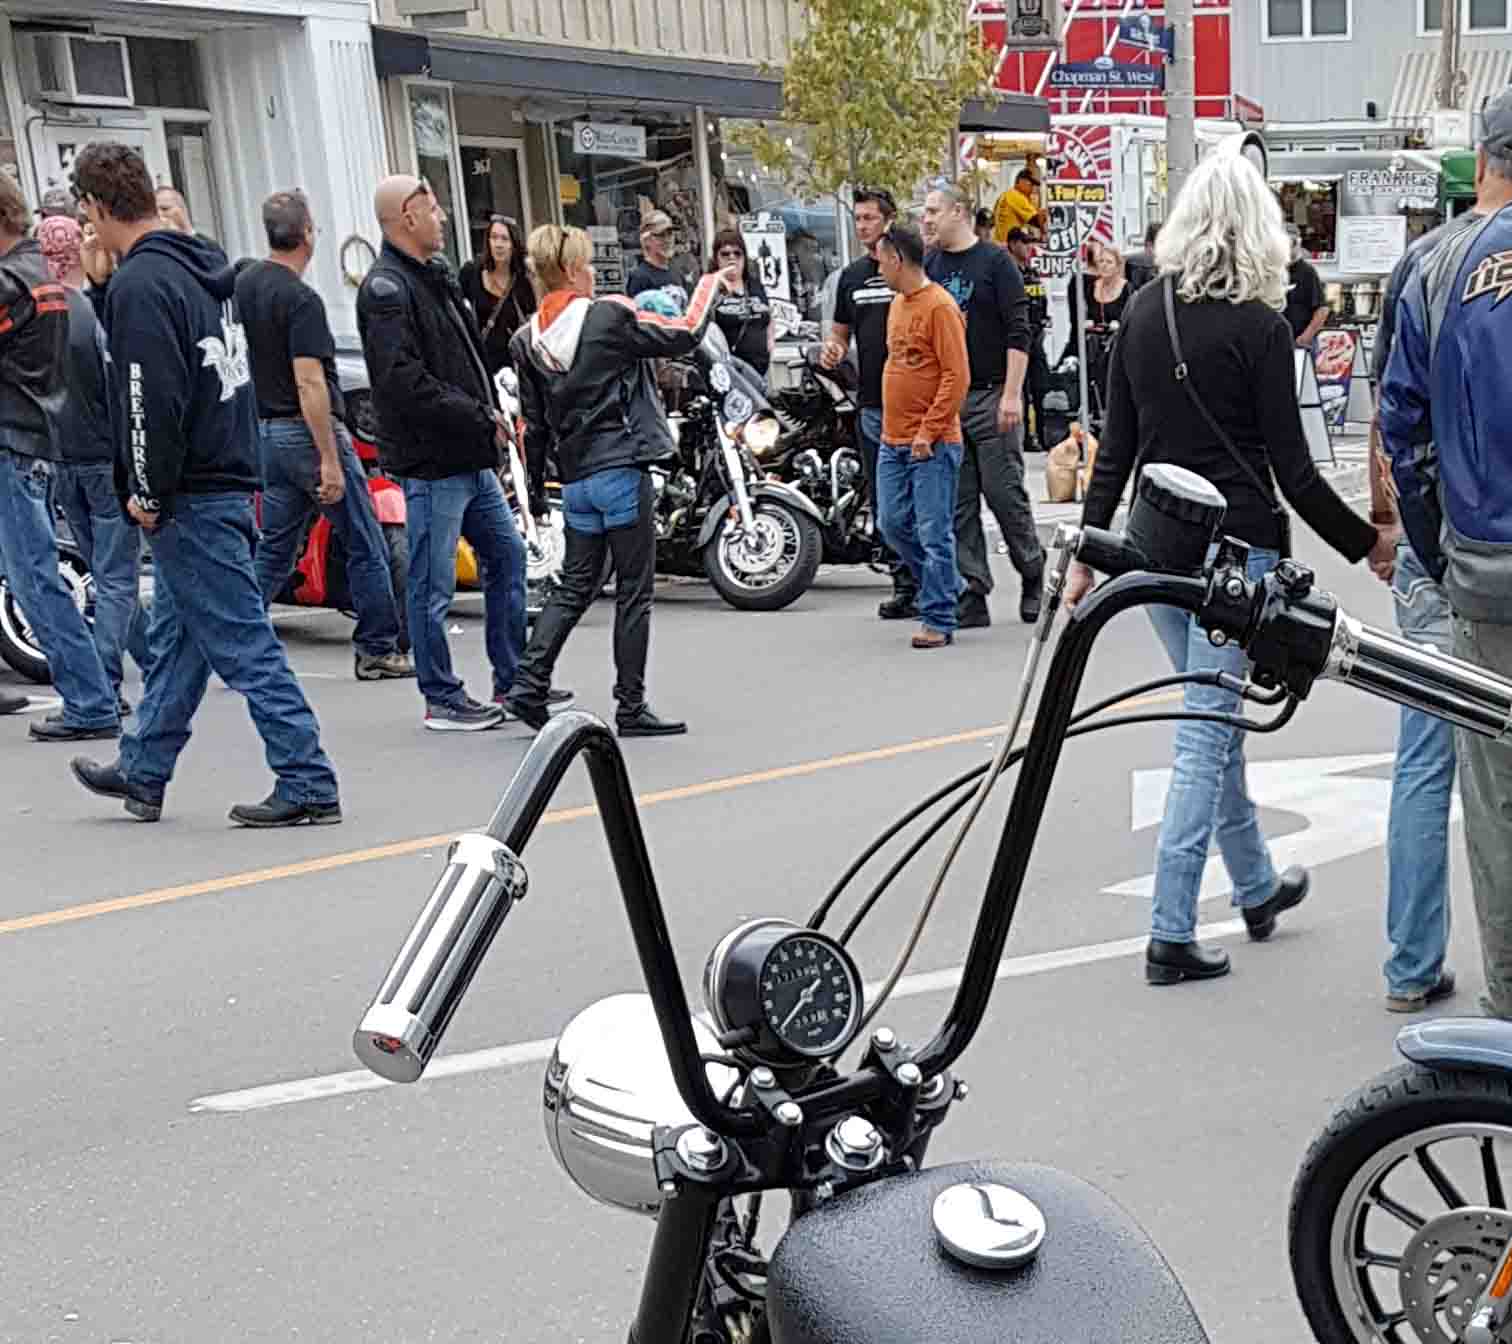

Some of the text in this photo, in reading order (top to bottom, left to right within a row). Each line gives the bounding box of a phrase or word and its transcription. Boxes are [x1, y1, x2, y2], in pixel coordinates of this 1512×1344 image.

[1051, 70, 1107, 85] Chapman
[1127, 70, 1155, 83] West
[757, 256, 778, 288] 13
